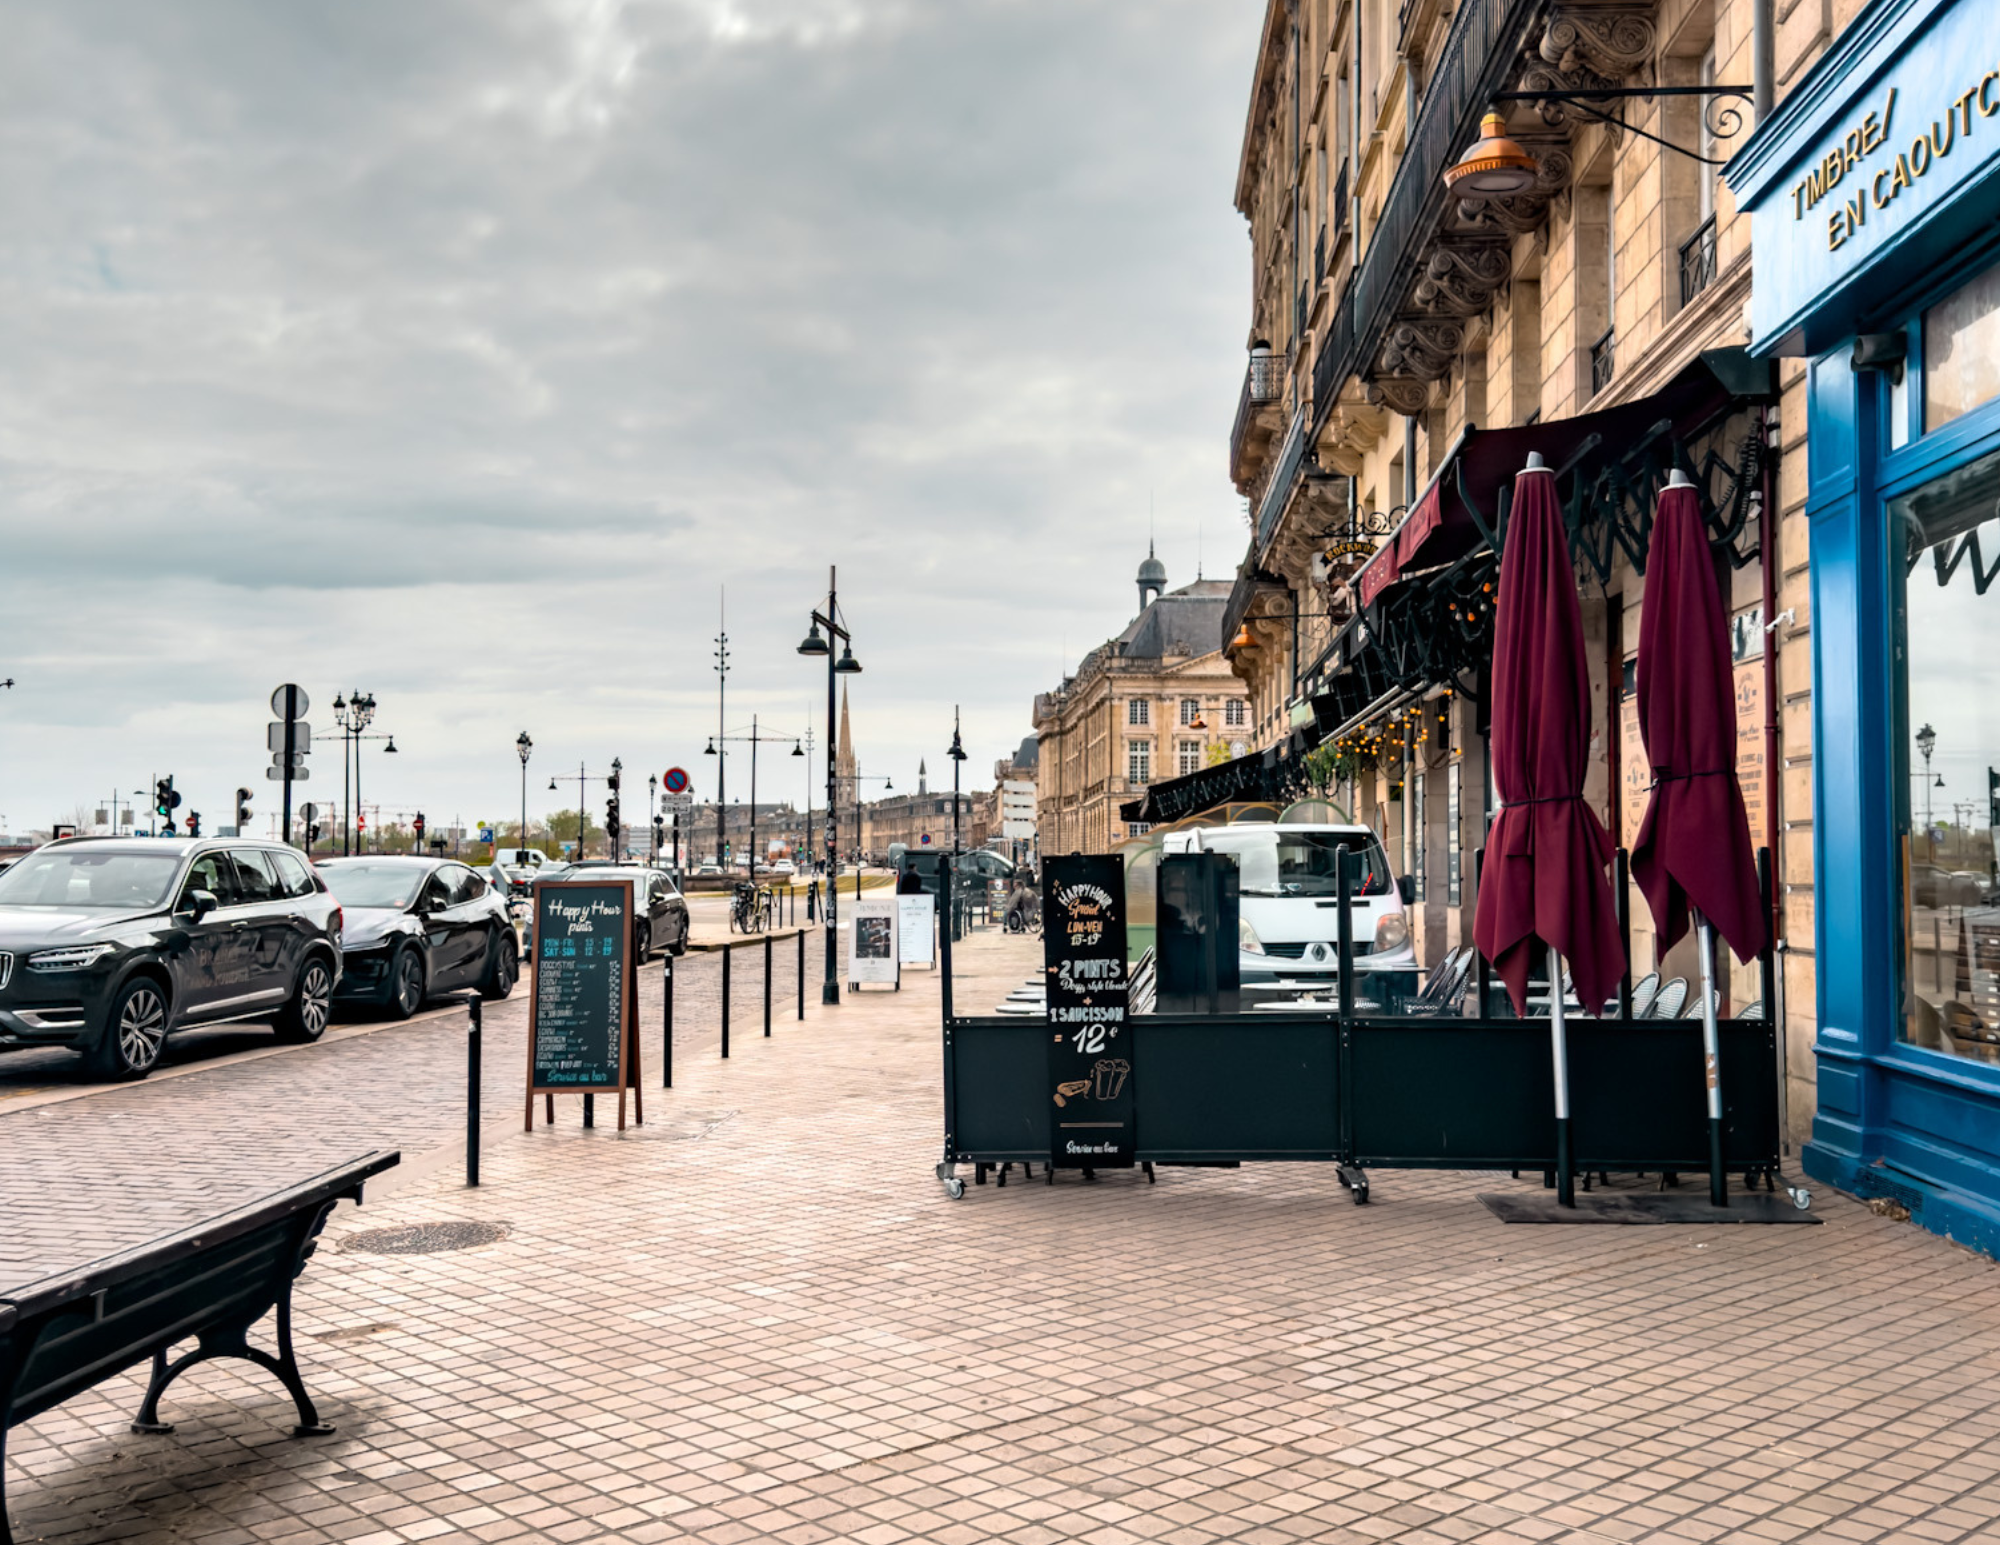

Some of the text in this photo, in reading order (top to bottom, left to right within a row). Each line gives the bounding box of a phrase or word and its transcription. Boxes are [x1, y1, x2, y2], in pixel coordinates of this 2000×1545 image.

[1829, 62, 2000, 251] EN CAOUTC
[1325, 543, 1377, 560] ROCKWOO
[1057, 884, 1113, 910] HAPPY HOUR
[548, 899, 622, 922] Happy Hour
[567, 921, 594, 936] pints
[1059, 959, 1121, 978] 2 PINTS
[1050, 1007, 1124, 1022] 1 SAUCISSON
[1072, 1023, 1106, 1054] 12
[547, 1069, 577, 1082] Service
[1066, 1140, 1092, 1154] Service
